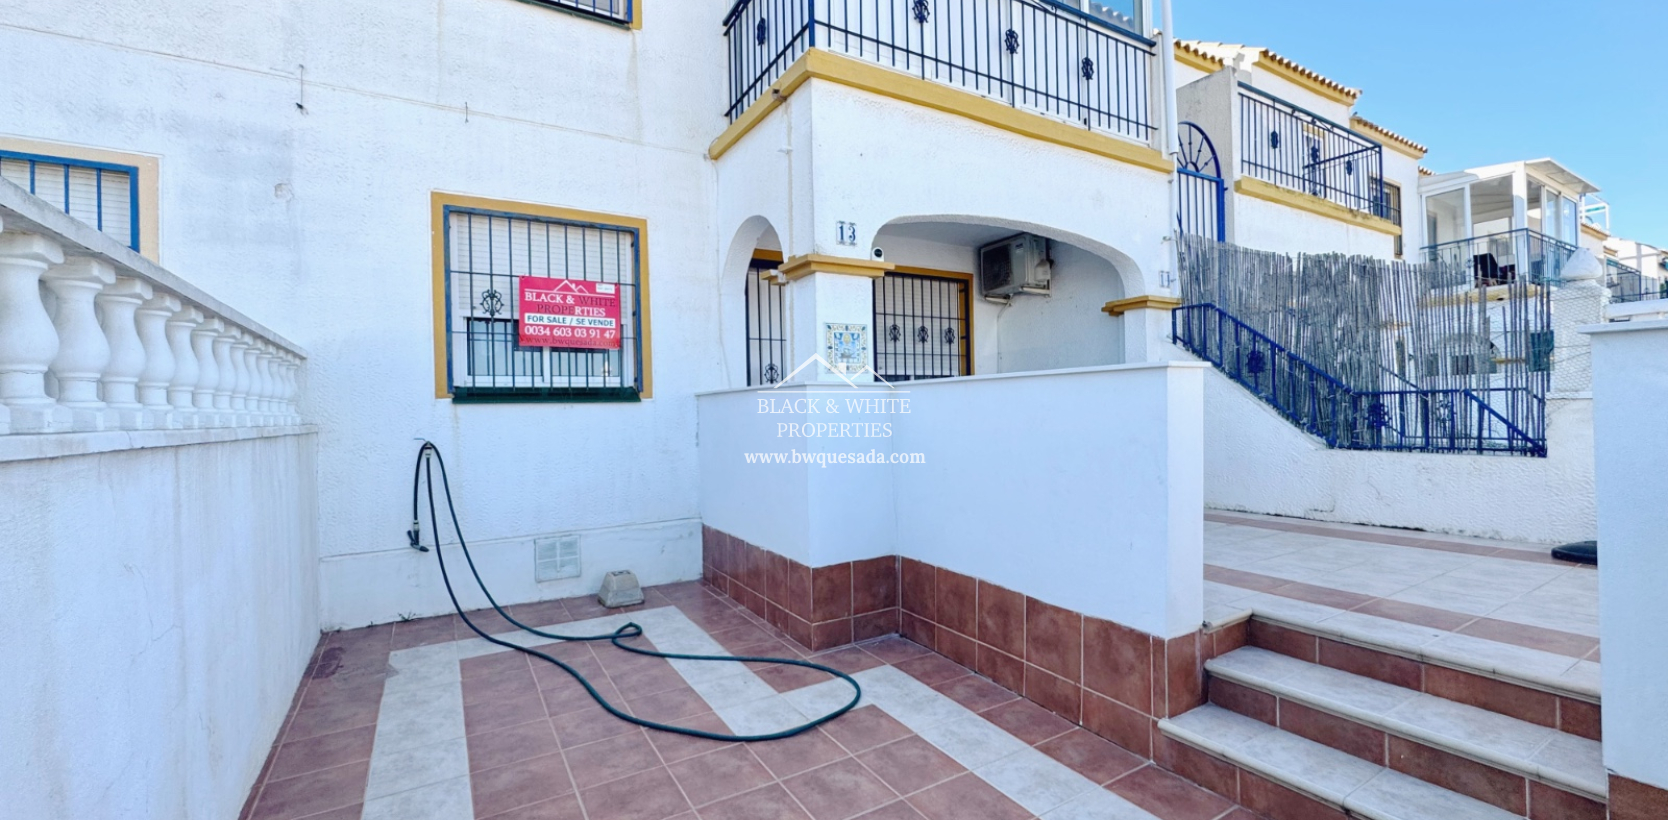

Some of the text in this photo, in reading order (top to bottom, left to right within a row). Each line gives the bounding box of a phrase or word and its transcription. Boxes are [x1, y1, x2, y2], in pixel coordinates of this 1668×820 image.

[839, 225, 856, 242] 13
[524, 292, 616, 307] BLACK & WHITE
[536, 304, 606, 317] PROPERTIES
[527, 315, 545, 323] FOR
[546, 316, 567, 325] SALE
[575, 318, 586, 326] SE
[588, 318, 614, 327] VENDE
[524, 325, 616, 339] 0034 603 03 91 47
